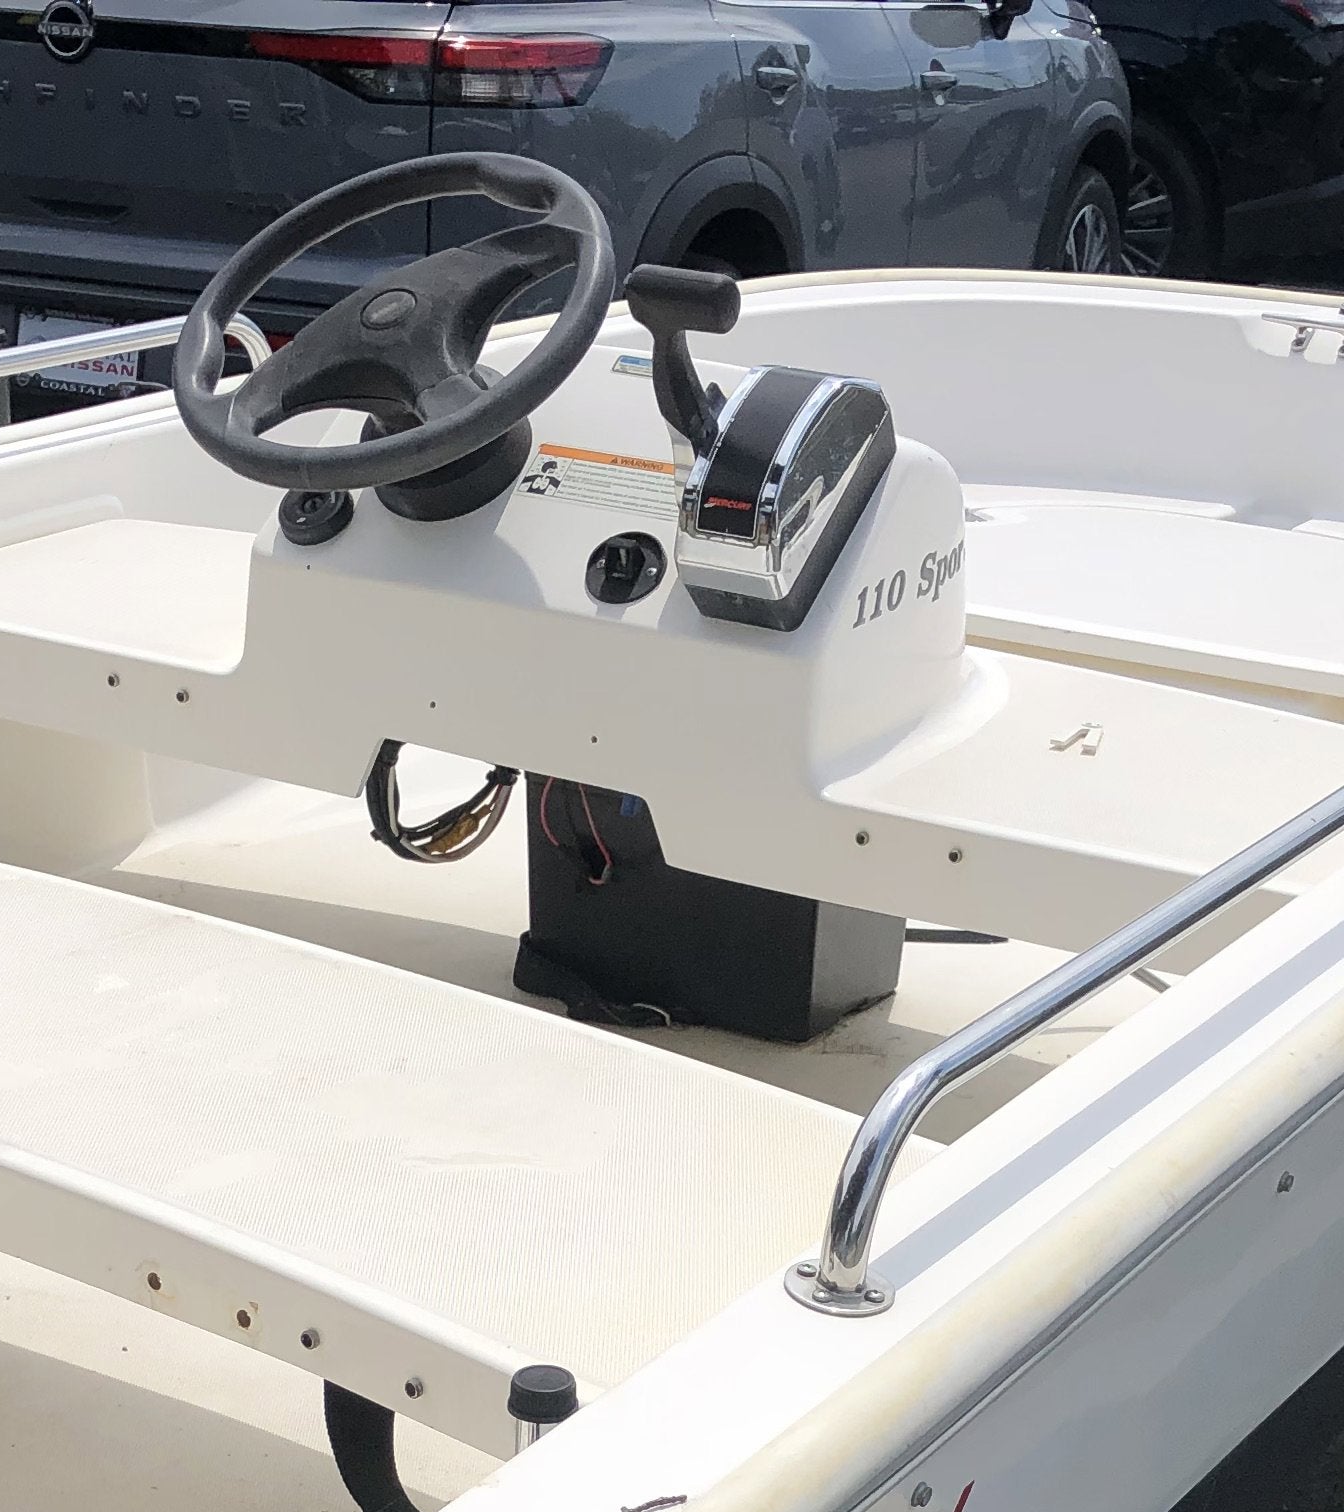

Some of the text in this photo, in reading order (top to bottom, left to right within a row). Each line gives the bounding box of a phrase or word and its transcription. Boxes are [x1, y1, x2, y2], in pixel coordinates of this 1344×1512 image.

[37, 23, 94, 37] NISSAN
[62, 360, 135, 377] ISSAN
[40, 379, 105, 397] COASTAL
[619, 458, 665, 471] WARNING
[852, 539, 966, 629] 110 Spor
